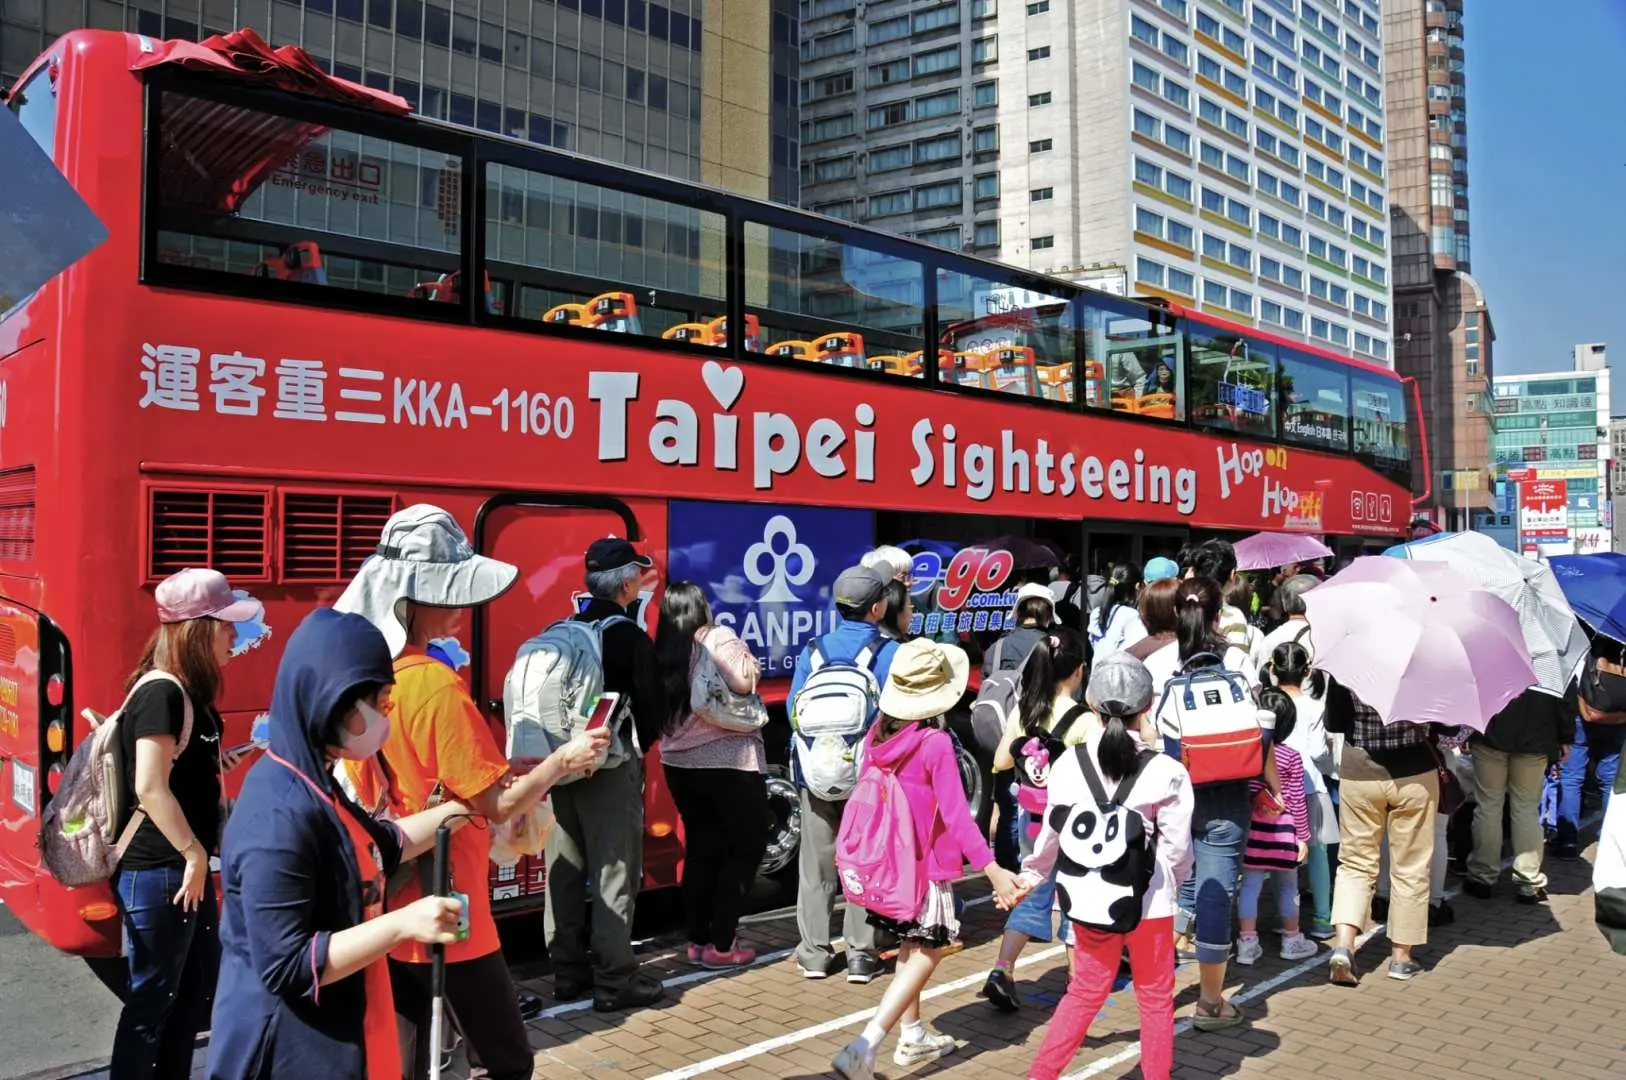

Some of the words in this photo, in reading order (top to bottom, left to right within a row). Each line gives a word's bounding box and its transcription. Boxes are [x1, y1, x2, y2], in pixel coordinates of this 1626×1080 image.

[272, 174, 348, 200] Emergency
[352, 192, 380, 205] exit
[392, 376, 576, 440] KKA-1160
[1297, 422, 1316, 437] English
[588, 360, 877, 490] Taipei
[910, 417, 1197, 515] Sightseeing
[1217, 442, 1264, 500] Hop
[1265, 447, 1288, 471] on
[1261, 475, 1299, 518] Hop
